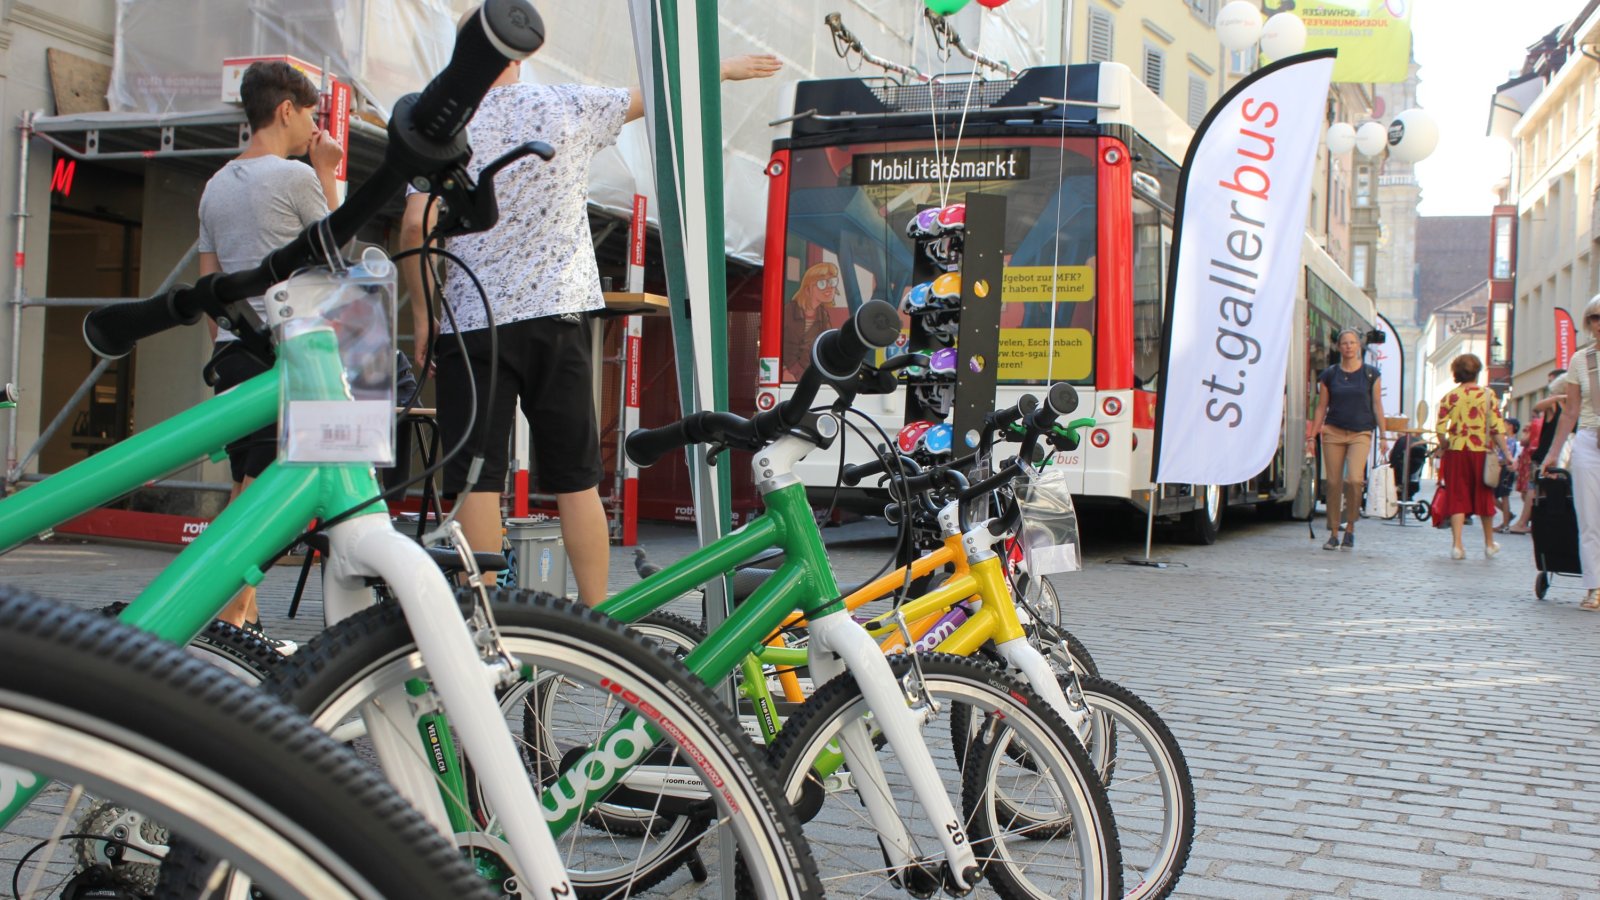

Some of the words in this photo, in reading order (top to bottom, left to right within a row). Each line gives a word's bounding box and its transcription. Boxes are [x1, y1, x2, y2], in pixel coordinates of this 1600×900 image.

[50, 158, 76, 197] M
[870, 153, 1016, 182] Mobilitätsmarkt
[1202, 97, 1279, 428] st.gallerbus
[1003, 273, 1034, 283] fgebot
[1055, 273, 1082, 282] MFK?
[1008, 285, 1038, 293] haben
[1041, 284, 1085, 293] Temine!
[998, 339, 1025, 347] velen,
[1028, 338, 1082, 347] Eschnbach
[998, 361, 1023, 369] eren!
[1052, 452, 1079, 465] rbus
[914, 621, 958, 652] oom
[665, 680, 740, 755] SCHWALBE
[750, 776, 786, 835] LITTLE
[782, 838, 801, 869] JOE
[946, 820, 965, 845] 20
[550, 881, 569, 900] 2
